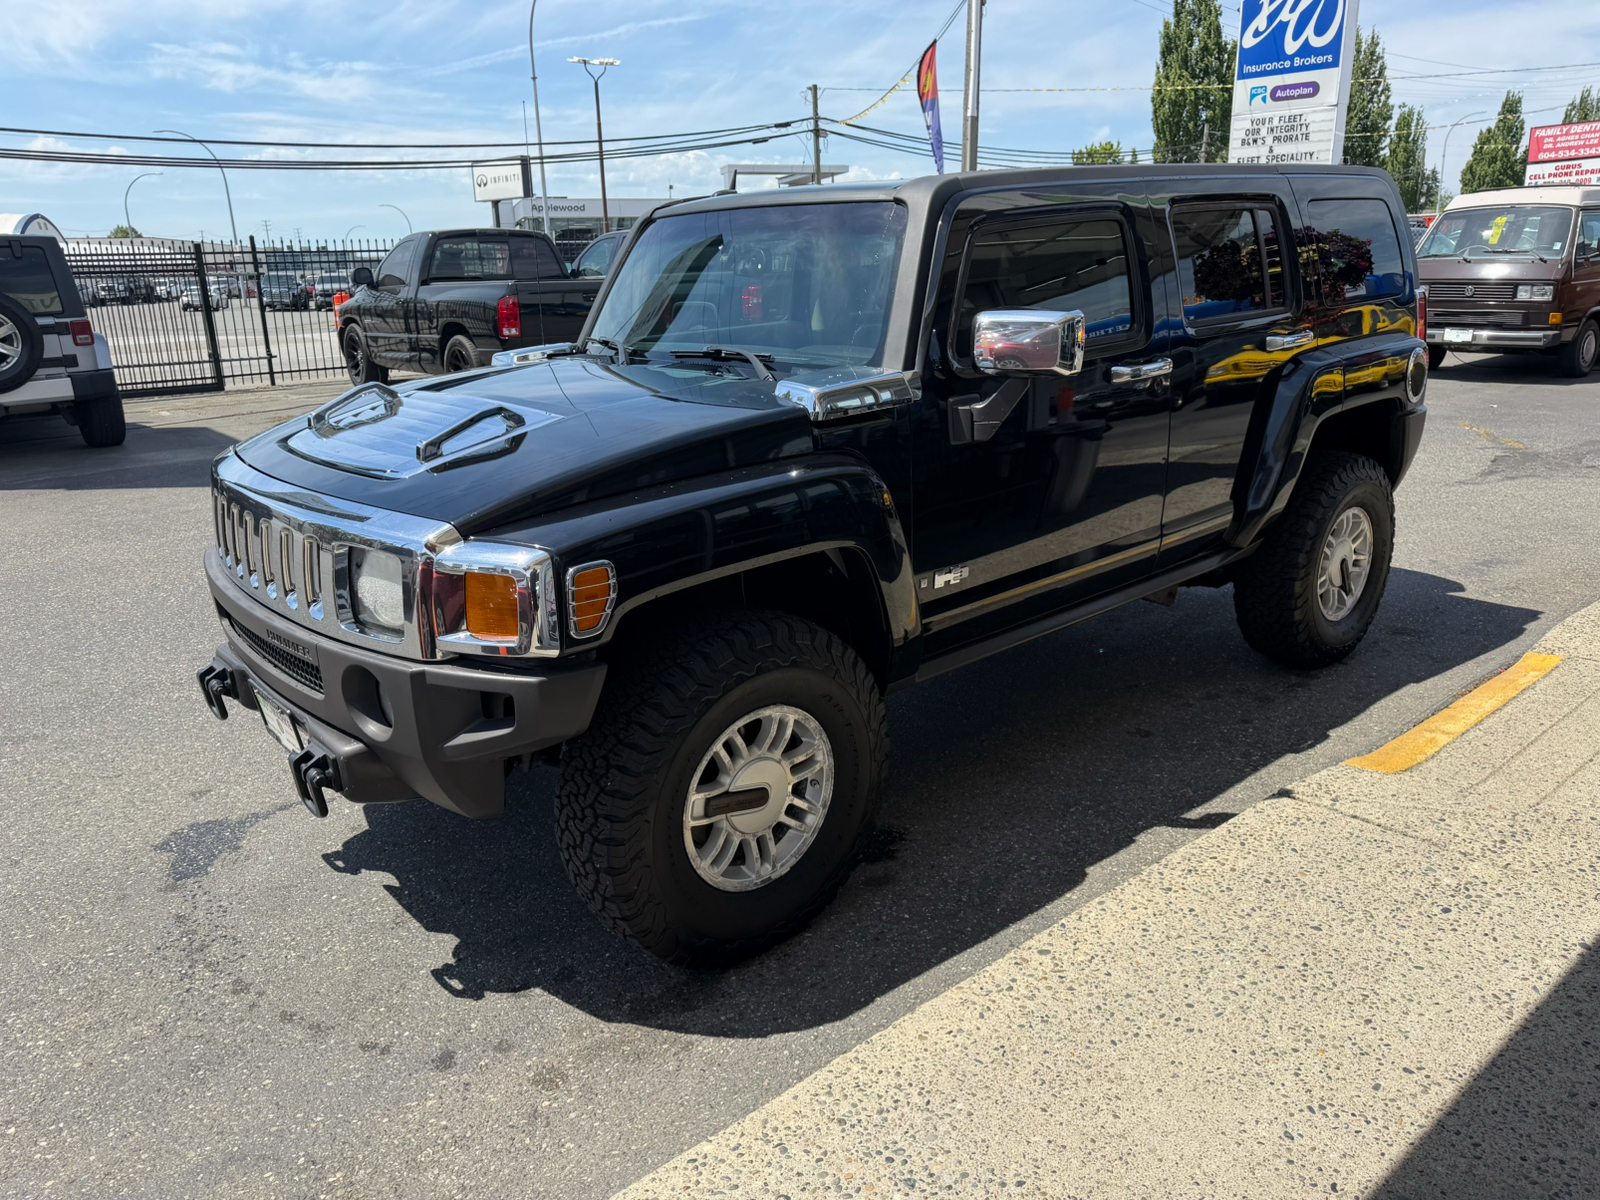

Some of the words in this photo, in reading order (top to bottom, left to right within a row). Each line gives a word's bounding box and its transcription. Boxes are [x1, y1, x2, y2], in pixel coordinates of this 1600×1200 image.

[1243, 61, 1291, 74] Insurance
[1294, 54, 1333, 67] Brokers
[1275, 86, 1313, 98] Autoplan
[1250, 116, 1274, 127] YOUR
[1278, 114, 1307, 124] FLEET.
[1244, 128, 1262, 137] OUR
[1266, 122, 1310, 135] INTEGRITY
[1534, 126, 1569, 138] FAMILY
[1272, 132, 1311, 144] PRORATE
[1556, 134, 1580, 142] AGNES
[1556, 140, 1585, 148] ANDREW
[1268, 145, 1274, 154] &
[1266, 151, 1319, 164] SPECIALITY.
[1554, 163, 1582, 172] GURUS
[490, 174, 520, 184] INFINITI
[1529, 173, 1546, 181] CELL
[1548, 170, 1574, 179] PHONE
[266, 628, 312, 660] HUMMER
